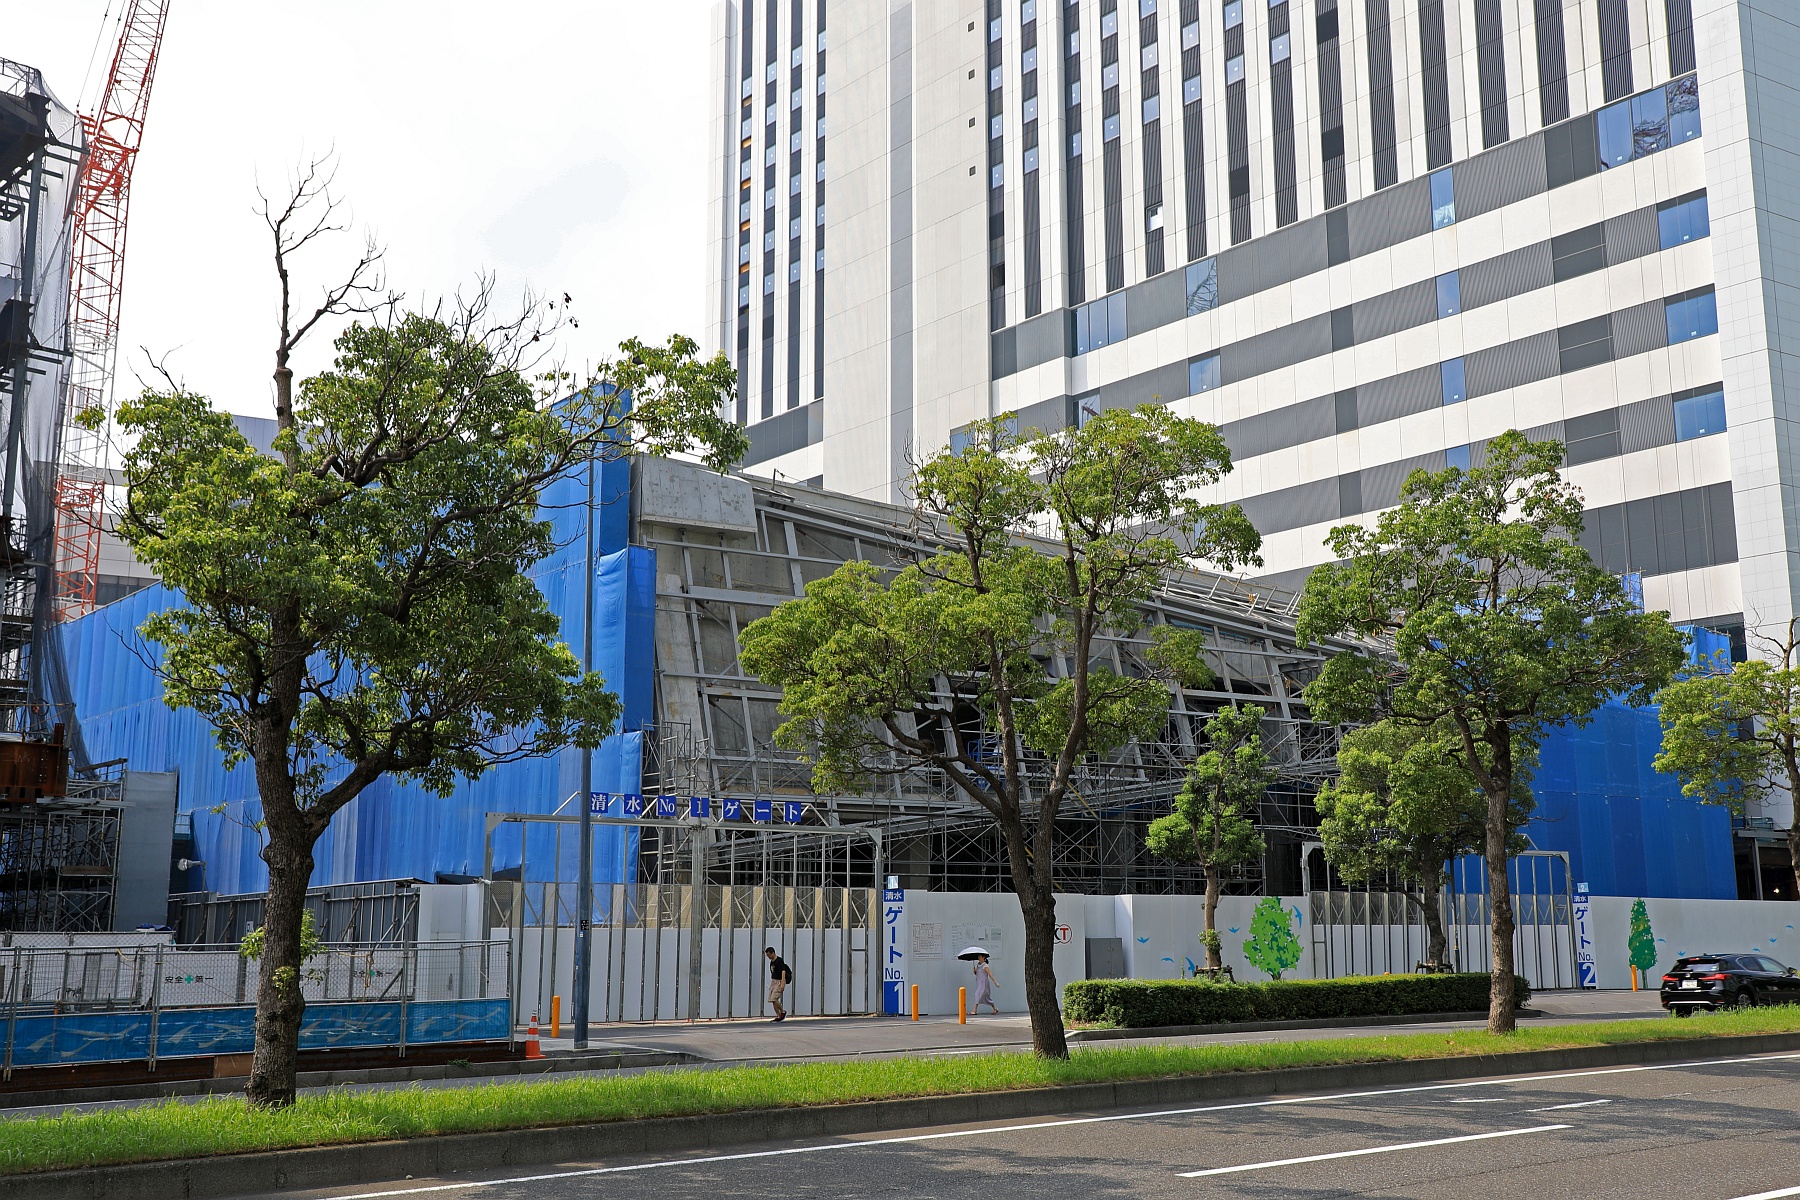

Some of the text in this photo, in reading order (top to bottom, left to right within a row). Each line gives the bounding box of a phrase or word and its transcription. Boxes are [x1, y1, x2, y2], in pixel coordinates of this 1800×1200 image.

[885, 891, 902, 901] 清水
[885, 906, 903, 963] ゲート
[1575, 906, 1597, 987] ゲート No. 2
[885, 967, 904, 980] No.
[894, 981, 904, 1015] 1
